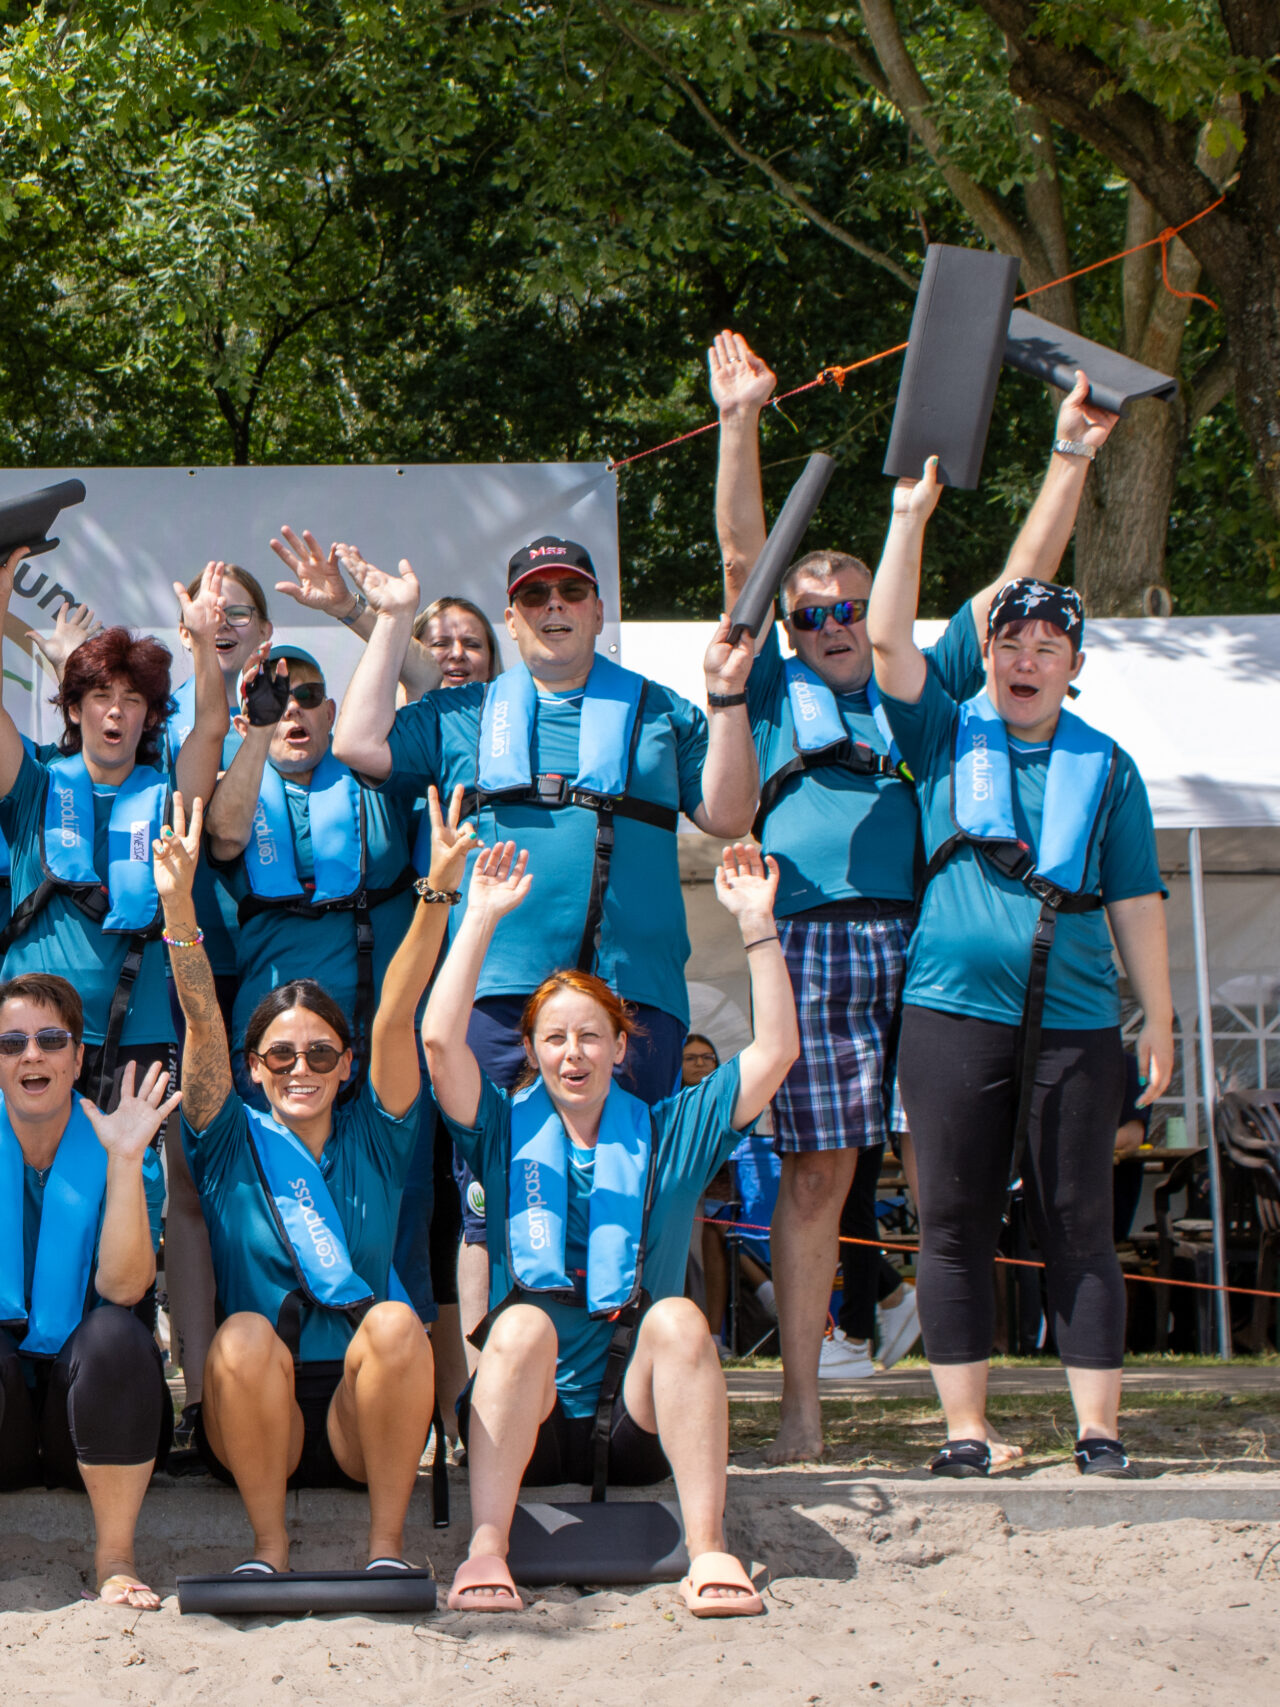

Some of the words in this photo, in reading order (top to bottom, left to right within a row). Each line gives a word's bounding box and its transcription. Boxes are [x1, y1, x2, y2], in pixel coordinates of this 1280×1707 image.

[491, 700, 511, 758] compass
[972, 733, 993, 801] compass
[60, 788, 80, 848] compass
[291, 1177, 336, 1268] compass
[524, 1160, 548, 1250] compass
